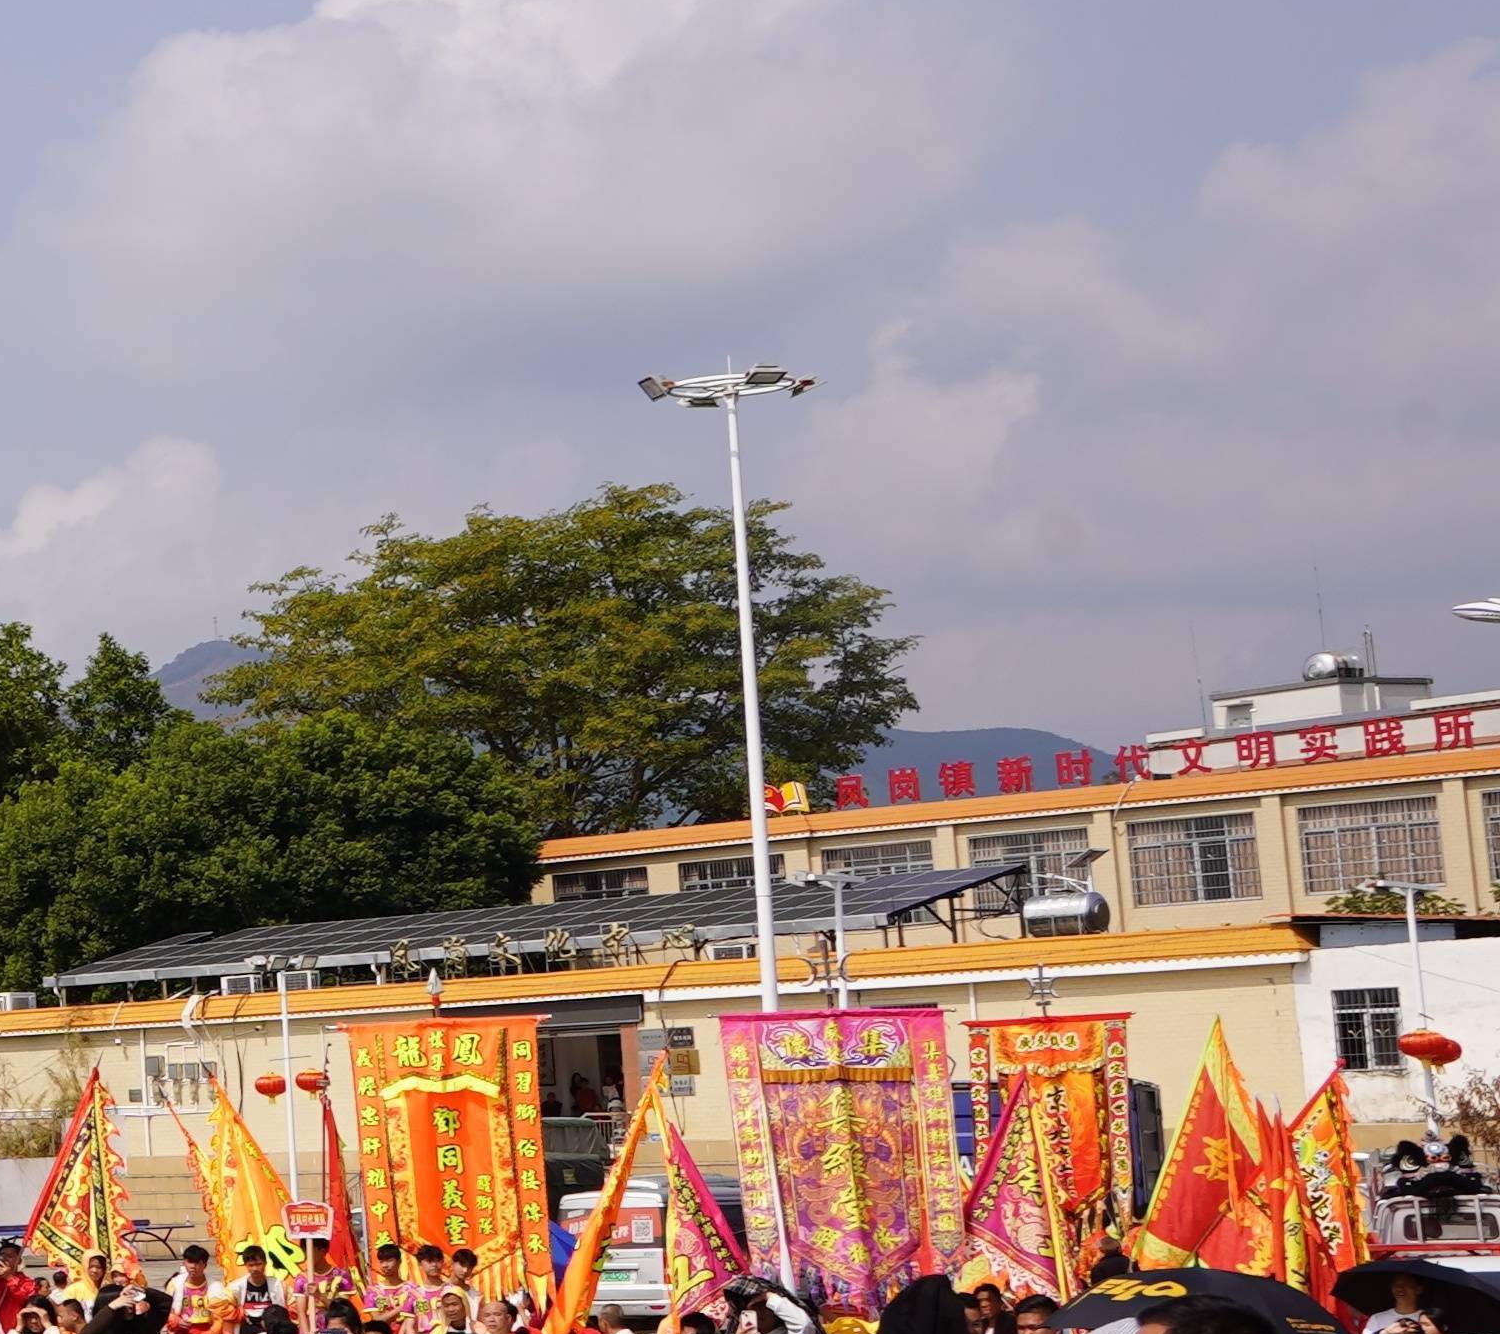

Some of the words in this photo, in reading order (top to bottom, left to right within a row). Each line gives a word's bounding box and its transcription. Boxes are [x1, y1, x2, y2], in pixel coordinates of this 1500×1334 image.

[835, 708, 1475, 810] 凤岗镇新时代文明实践所
